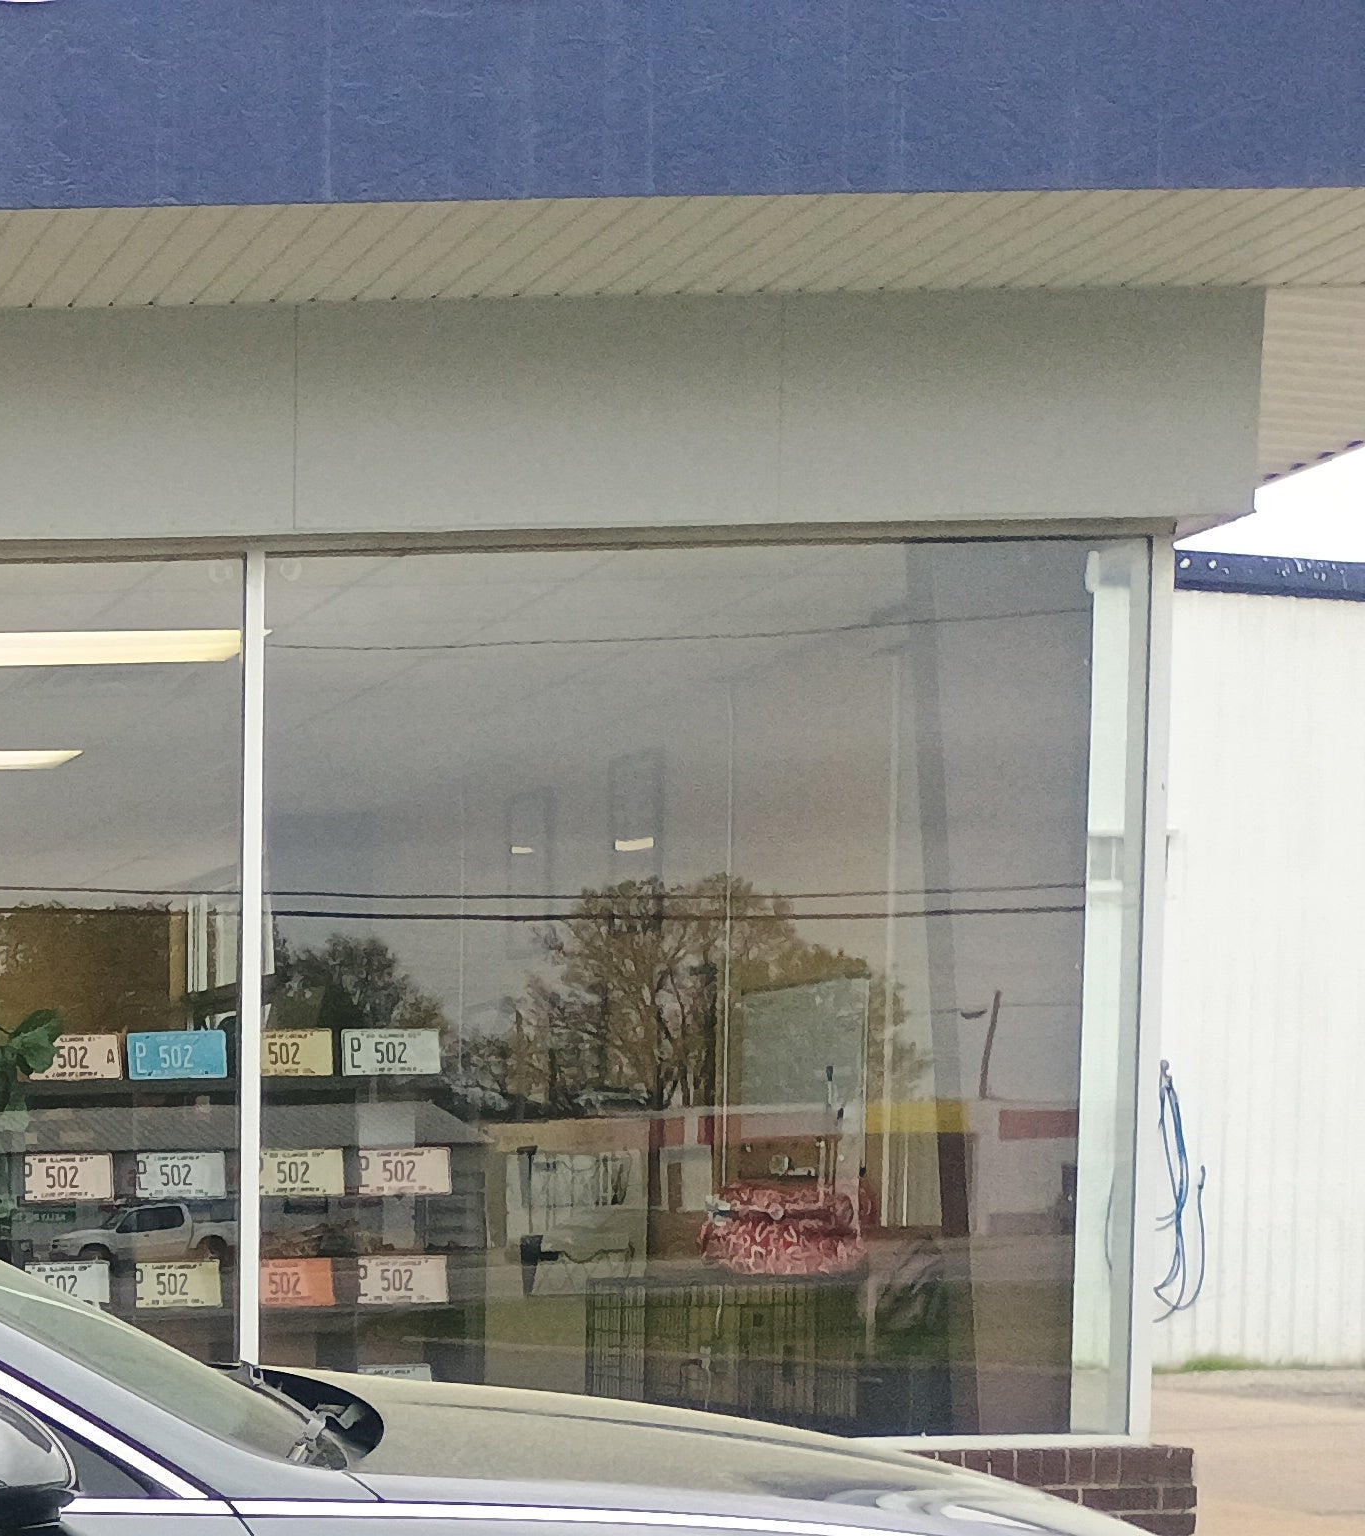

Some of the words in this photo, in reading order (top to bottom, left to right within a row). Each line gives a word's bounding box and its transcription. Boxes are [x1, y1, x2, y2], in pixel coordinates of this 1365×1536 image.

[57, 1046, 89, 1069] 502
[106, 1049, 115, 1064] A
[159, 1045, 194, 1068] 502
[268, 1042, 301, 1065] 502
[374, 1041, 407, 1064] 502
[45, 1165, 80, 1189] 502
[159, 1164, 193, 1187] 502
[276, 1160, 311, 1184] 502
[382, 1159, 417, 1182] 502
[156, 1272, 189, 1296] 502
[268, 1271, 302, 1296] 502
[380, 1268, 414, 1292] 502
